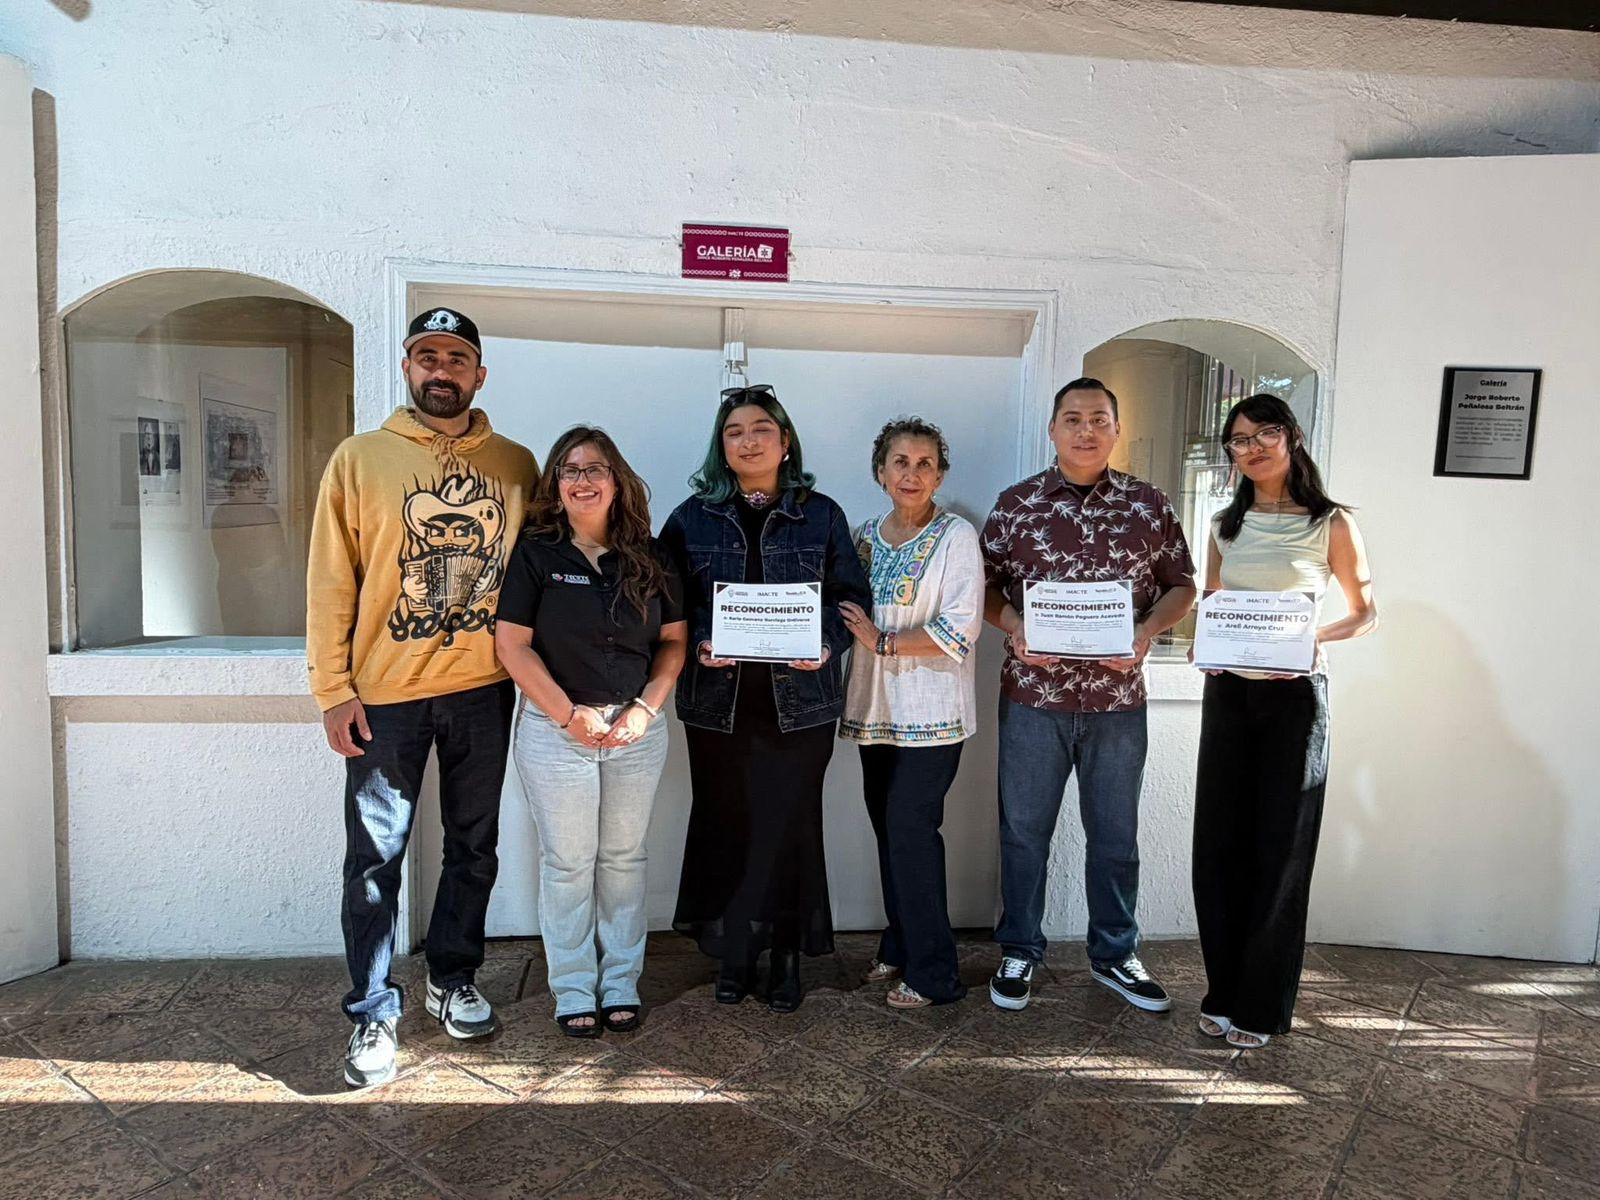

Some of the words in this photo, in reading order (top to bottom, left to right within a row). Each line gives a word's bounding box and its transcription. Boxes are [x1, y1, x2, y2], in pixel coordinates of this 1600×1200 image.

[697, 245, 757, 257] GALERÍA
[1480, 379, 1507, 387] Galería
[721, 605, 814, 613] RECONOCIMIENTO
[1031, 602, 1125, 611] RECONOCIMIENTO
[1205, 611, 1309, 622] RECONOCIMIENTO
